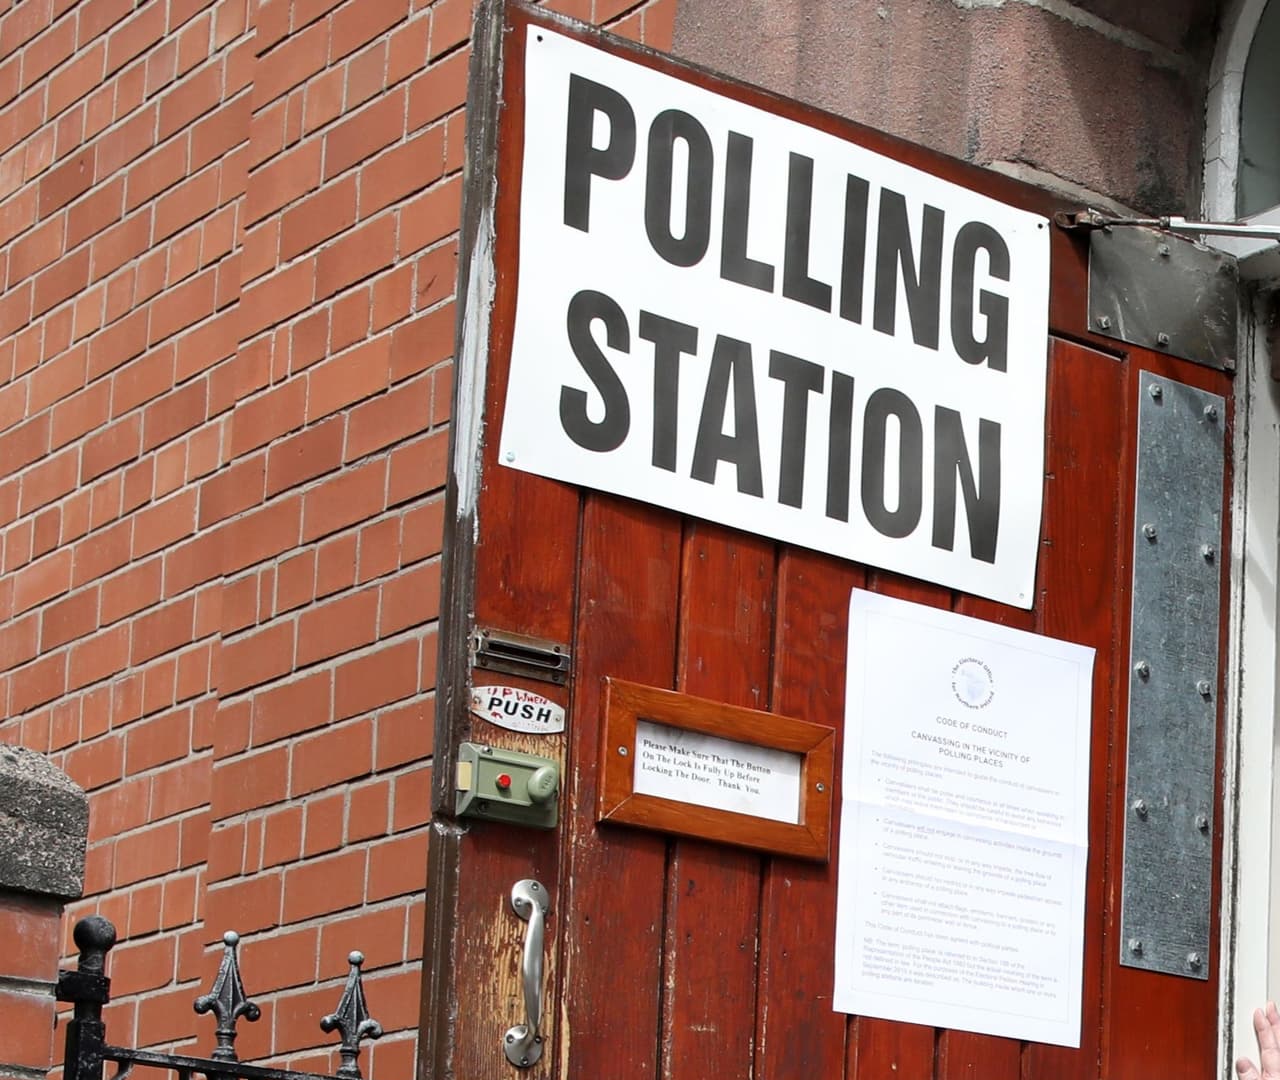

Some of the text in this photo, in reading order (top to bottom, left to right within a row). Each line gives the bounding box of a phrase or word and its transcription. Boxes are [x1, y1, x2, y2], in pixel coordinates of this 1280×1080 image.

[564, 73, 1010, 371] POLLING
[560, 289, 1001, 563] STATION
[488, 697, 552, 723] PUSH
[936, 715, 1008, 739] CODE OF CONDUCT
[643, 739, 771, 775] Please Make Sure That The Button
[911, 730, 961, 749] CANVASSING
[972, 744, 987, 754] THE
[988, 748, 1019, 761] VICINITY
[1020, 755, 1031, 764] OF
[938, 747, 1004, 768] POLLING PLACES
[642, 751, 760, 784] On The Lock Is Fully Up Before
[642, 762, 673, 777] Locking
[675, 769, 689, 779] The
[691, 772, 712, 784] Door.
[717, 778, 741, 791] Thank
